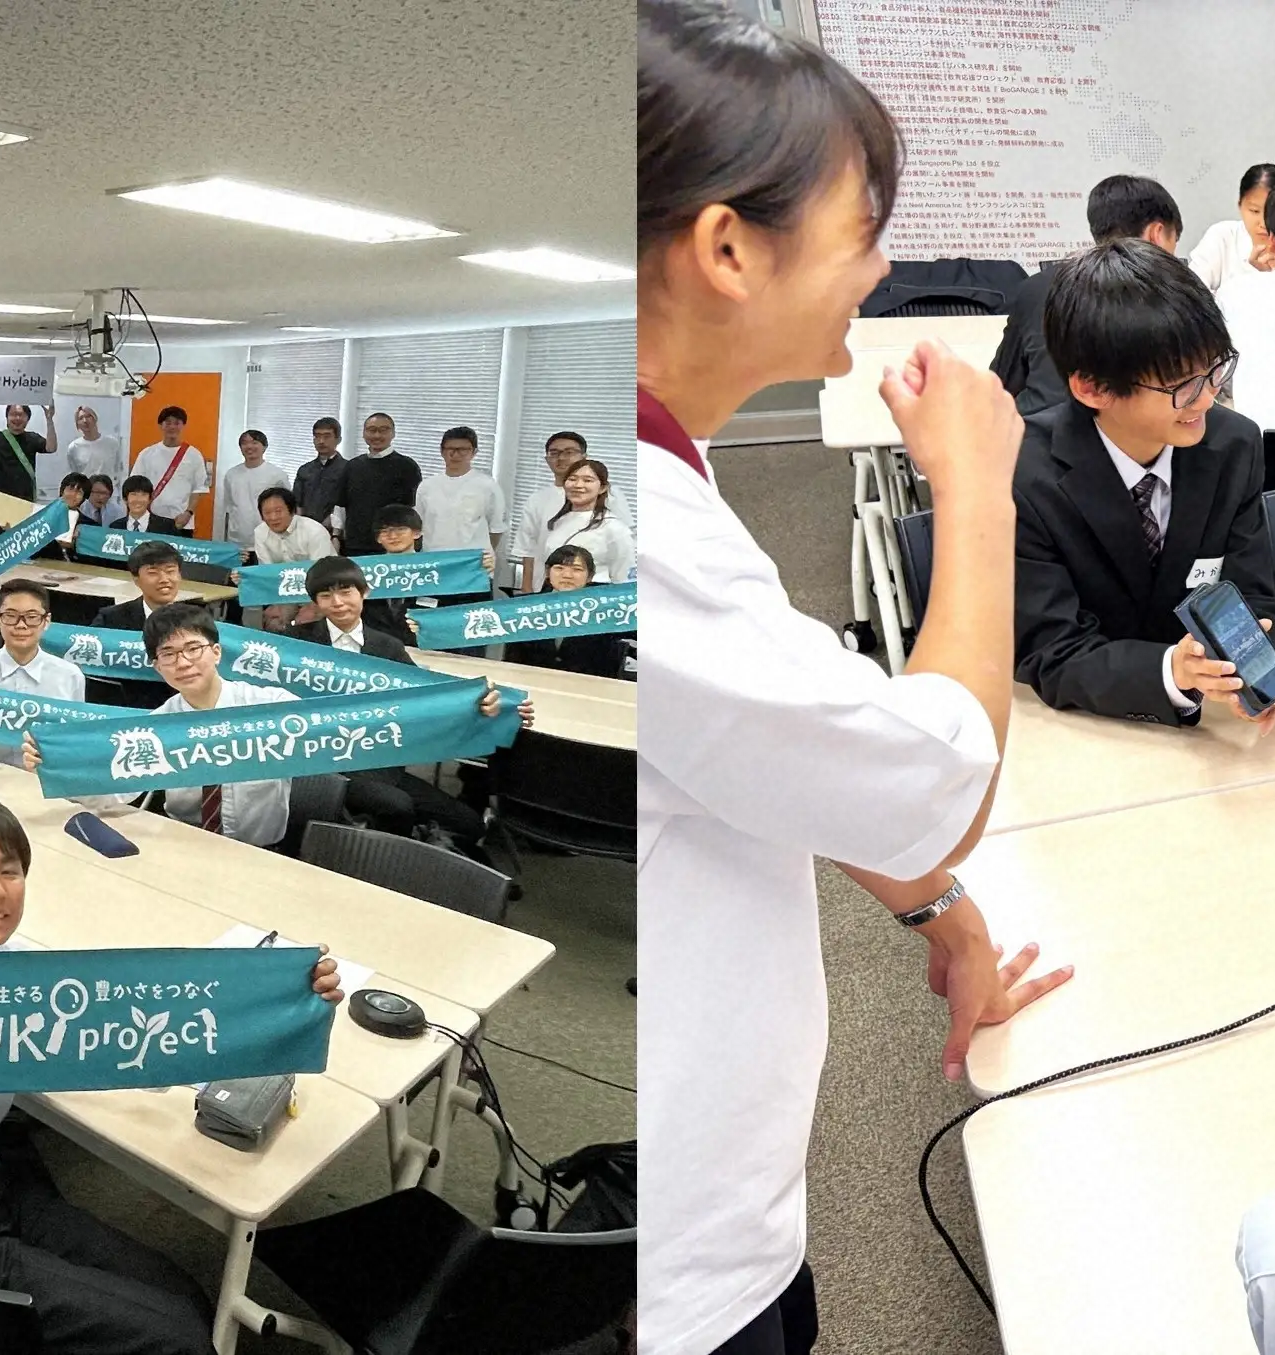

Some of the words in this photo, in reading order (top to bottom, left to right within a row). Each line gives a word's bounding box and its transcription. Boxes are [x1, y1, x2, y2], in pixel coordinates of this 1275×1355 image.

[2, 375, 48, 389] Hylable
[385, 569, 440, 592] project
[503, 597, 599, 633] TASUKI
[595, 601, 637, 626] proj
[105, 651, 154, 669] TASU
[186, 717, 276, 740] 地球と生きる
[310, 704, 401, 727] 豊かさをつなぐ
[169, 713, 309, 768] TASUKI
[303, 721, 403, 762] project
[94, 978, 221, 1001] 豊かさをつなぐ
[79, 1005, 218, 1071] project
